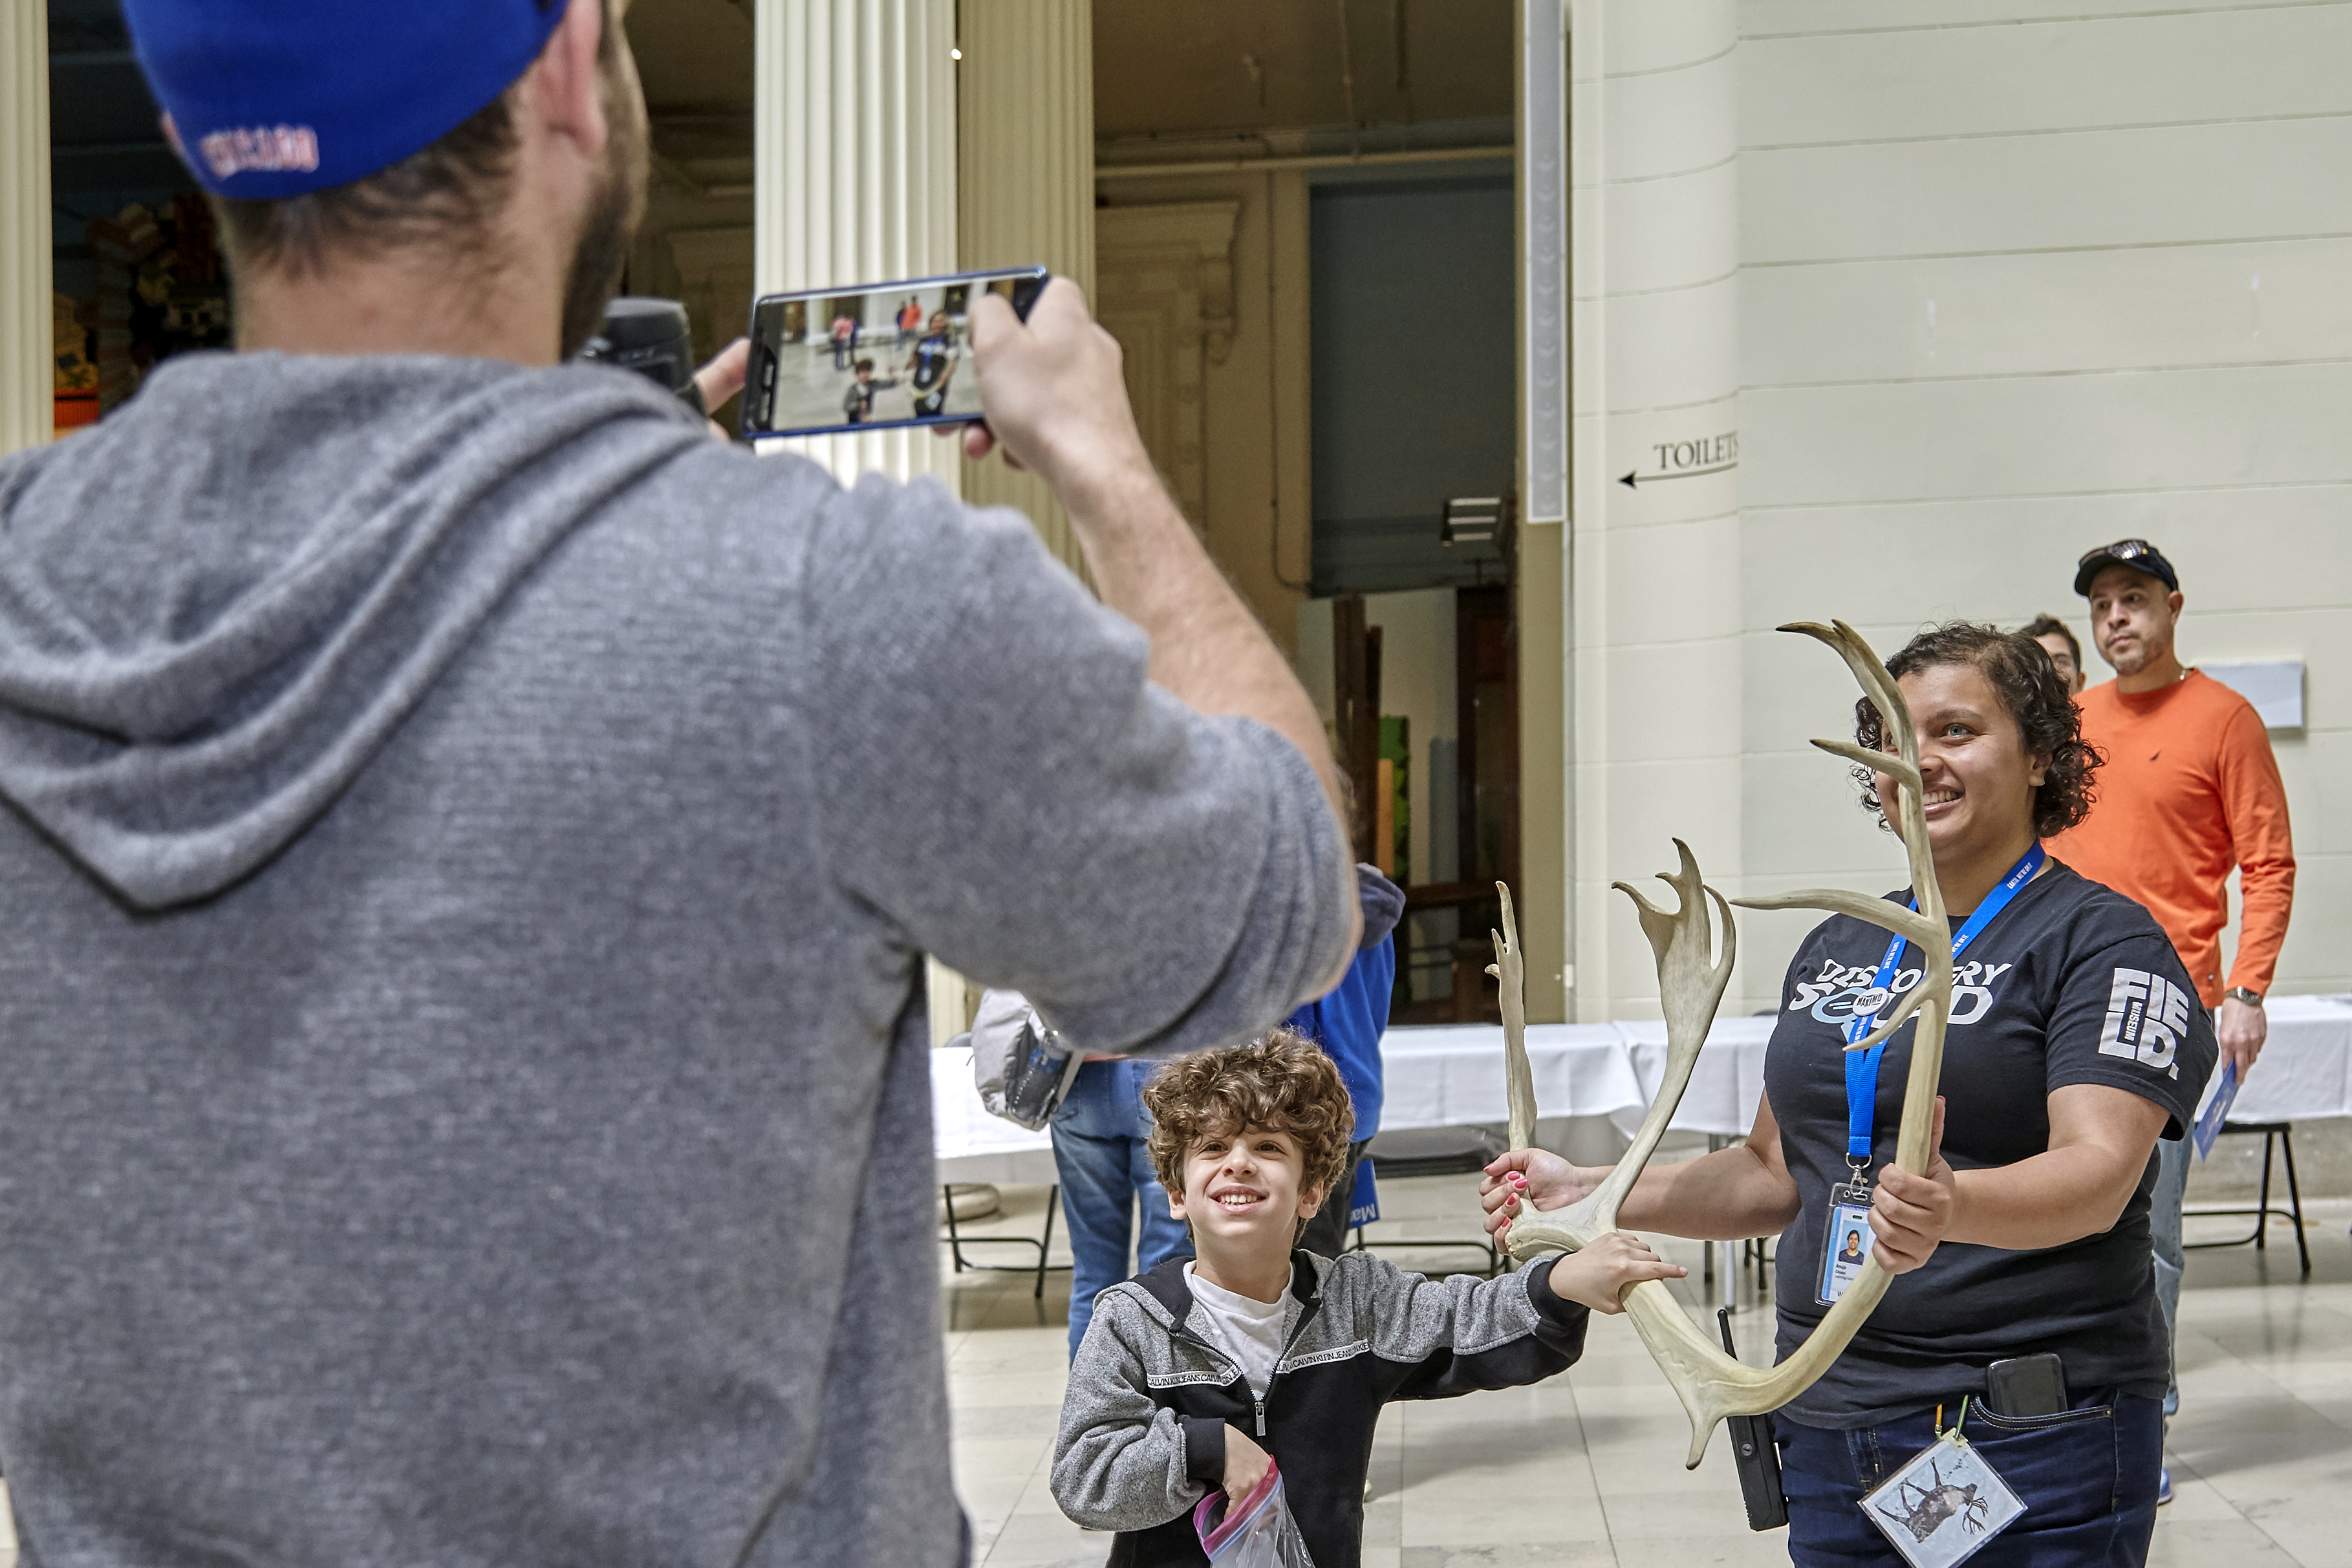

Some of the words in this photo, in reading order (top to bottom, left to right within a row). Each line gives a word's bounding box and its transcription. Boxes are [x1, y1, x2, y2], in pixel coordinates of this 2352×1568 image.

[1857, 994, 1883, 1007] MAXIMO
[2124, 1001, 2143, 1041] MUSEUM
[1293, 1355, 1316, 1367] CALVIN
[1316, 1353, 1335, 1362] KLEIN
